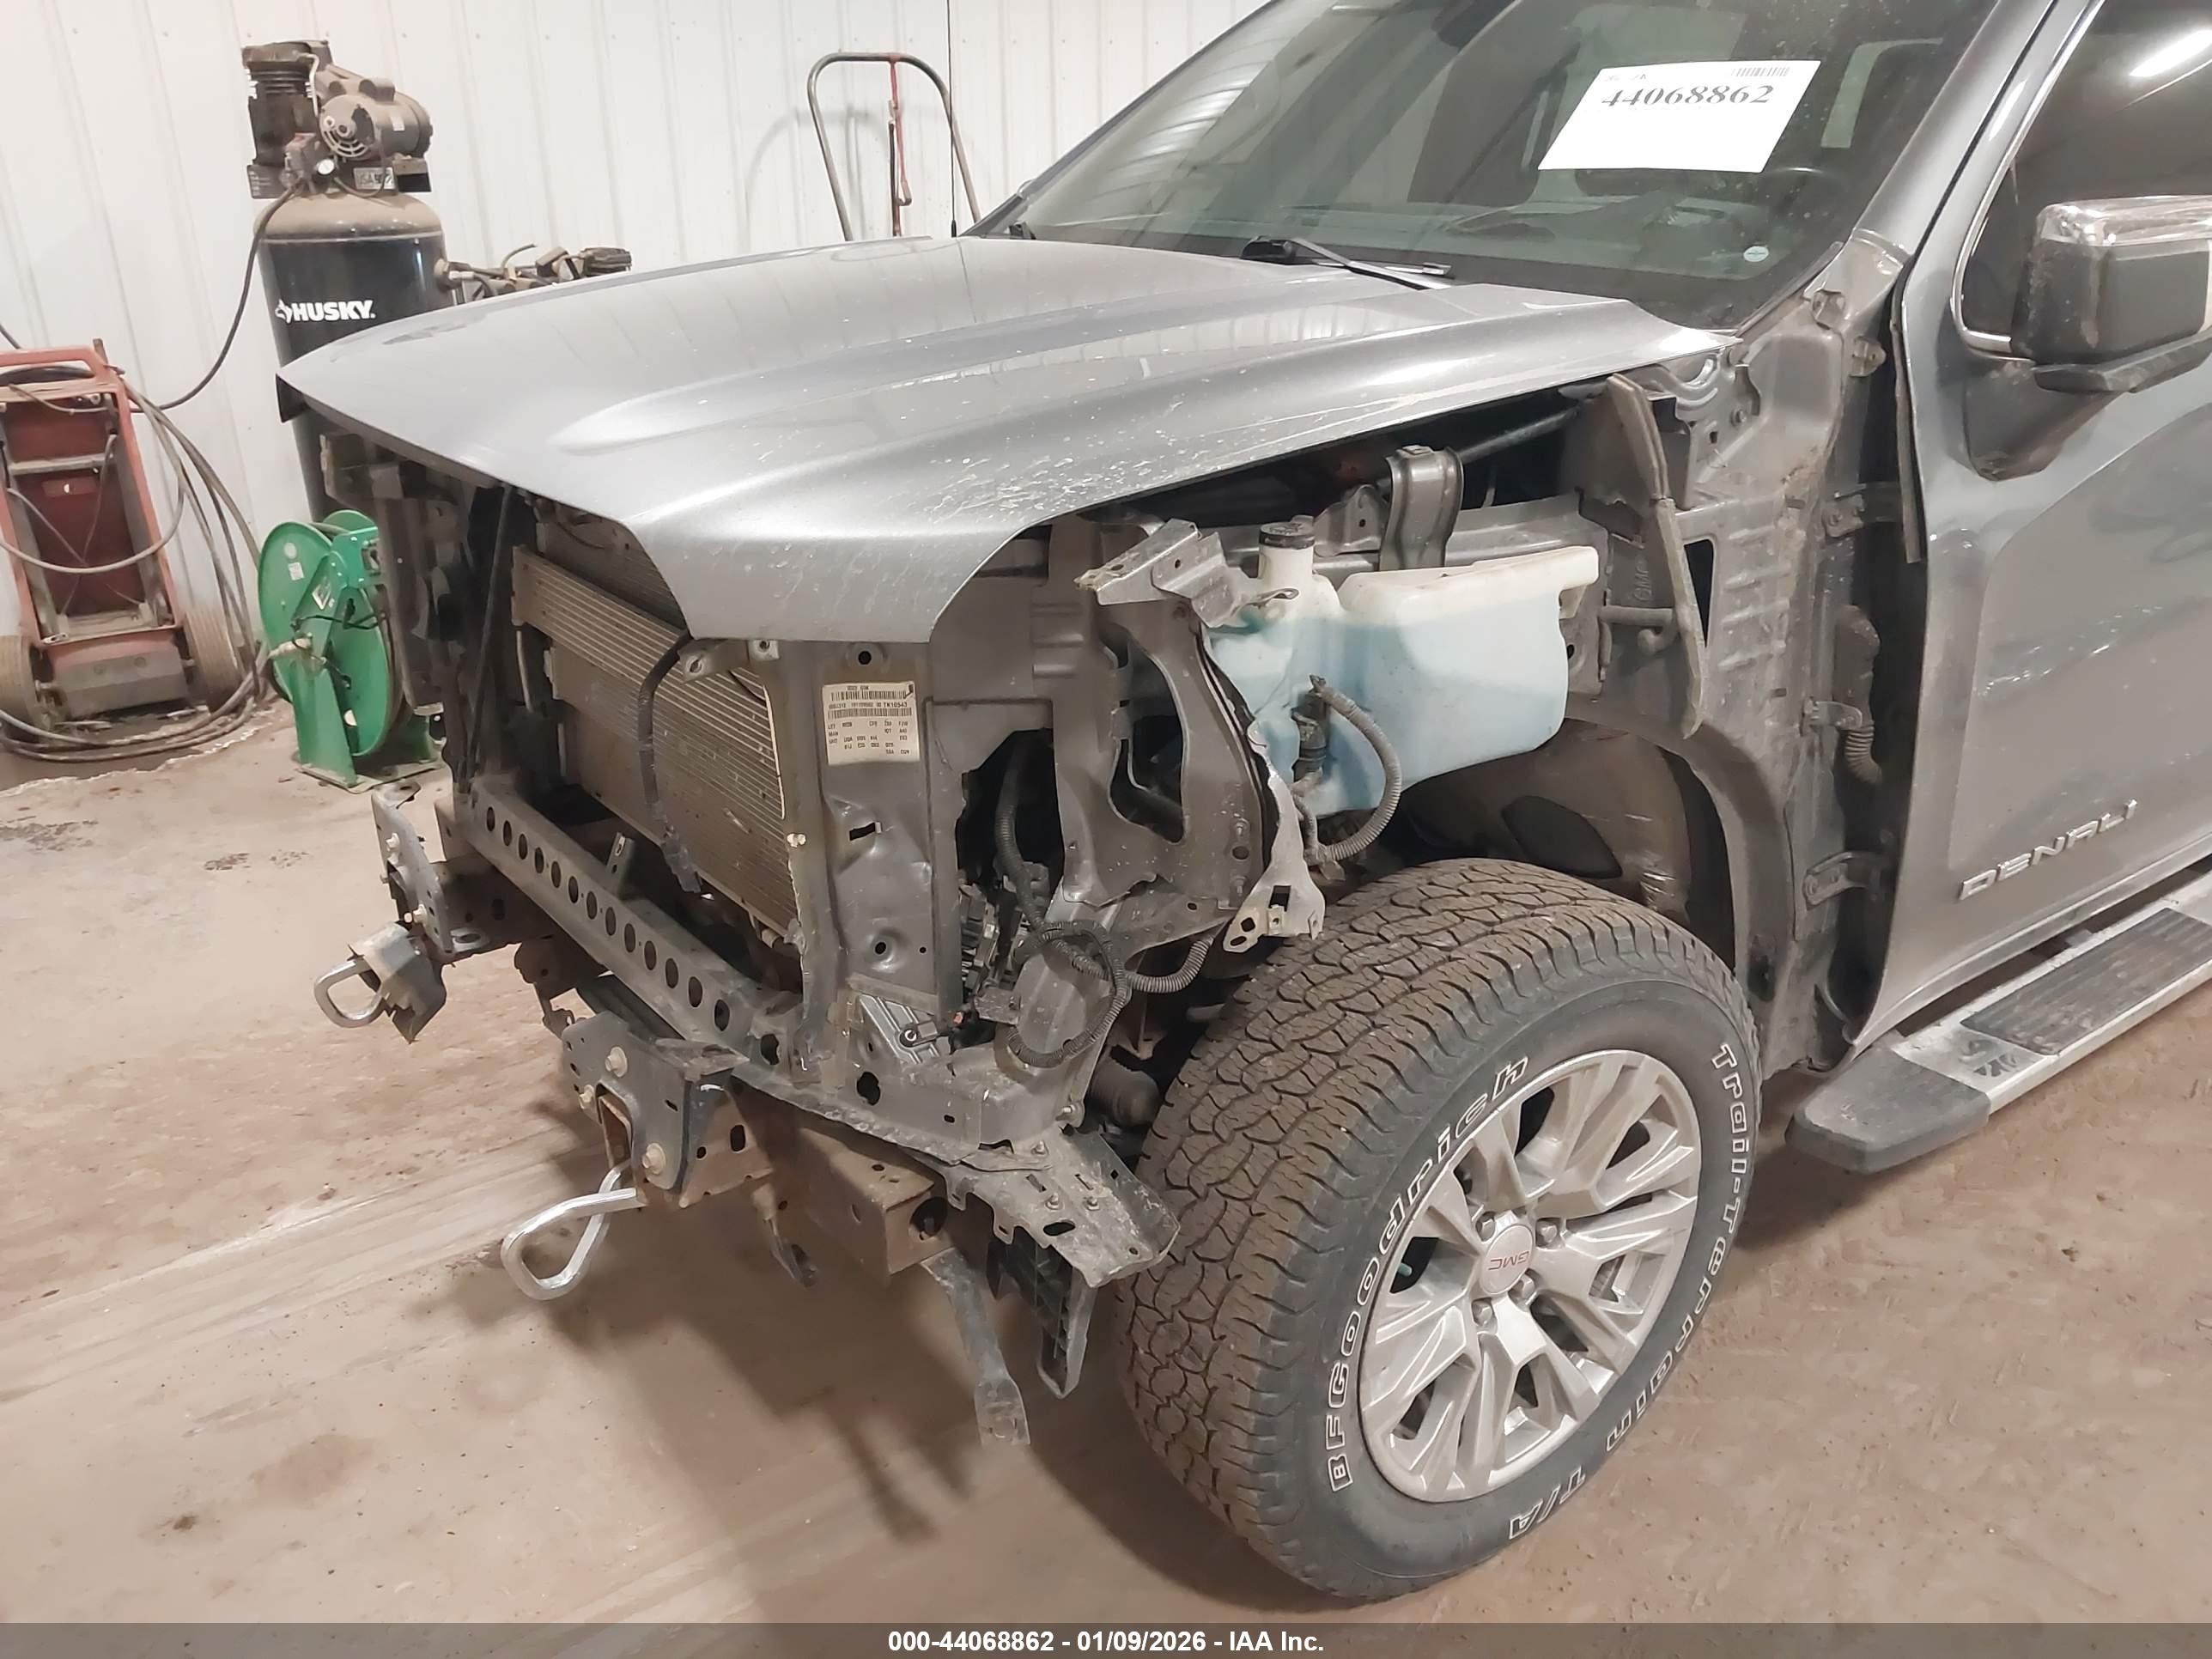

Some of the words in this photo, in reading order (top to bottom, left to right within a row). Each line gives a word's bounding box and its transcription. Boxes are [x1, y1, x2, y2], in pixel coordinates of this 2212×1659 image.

[1601, 85, 1775, 107] 44068862
[291, 300, 373, 321] HUSKY
[1958, 798, 2137, 901] DENALI
[1325, 1055, 1529, 1492] BFGoodrich
[1487, 1249, 1529, 1271] GMC
[1509, 1465, 1587, 1540] T/A
